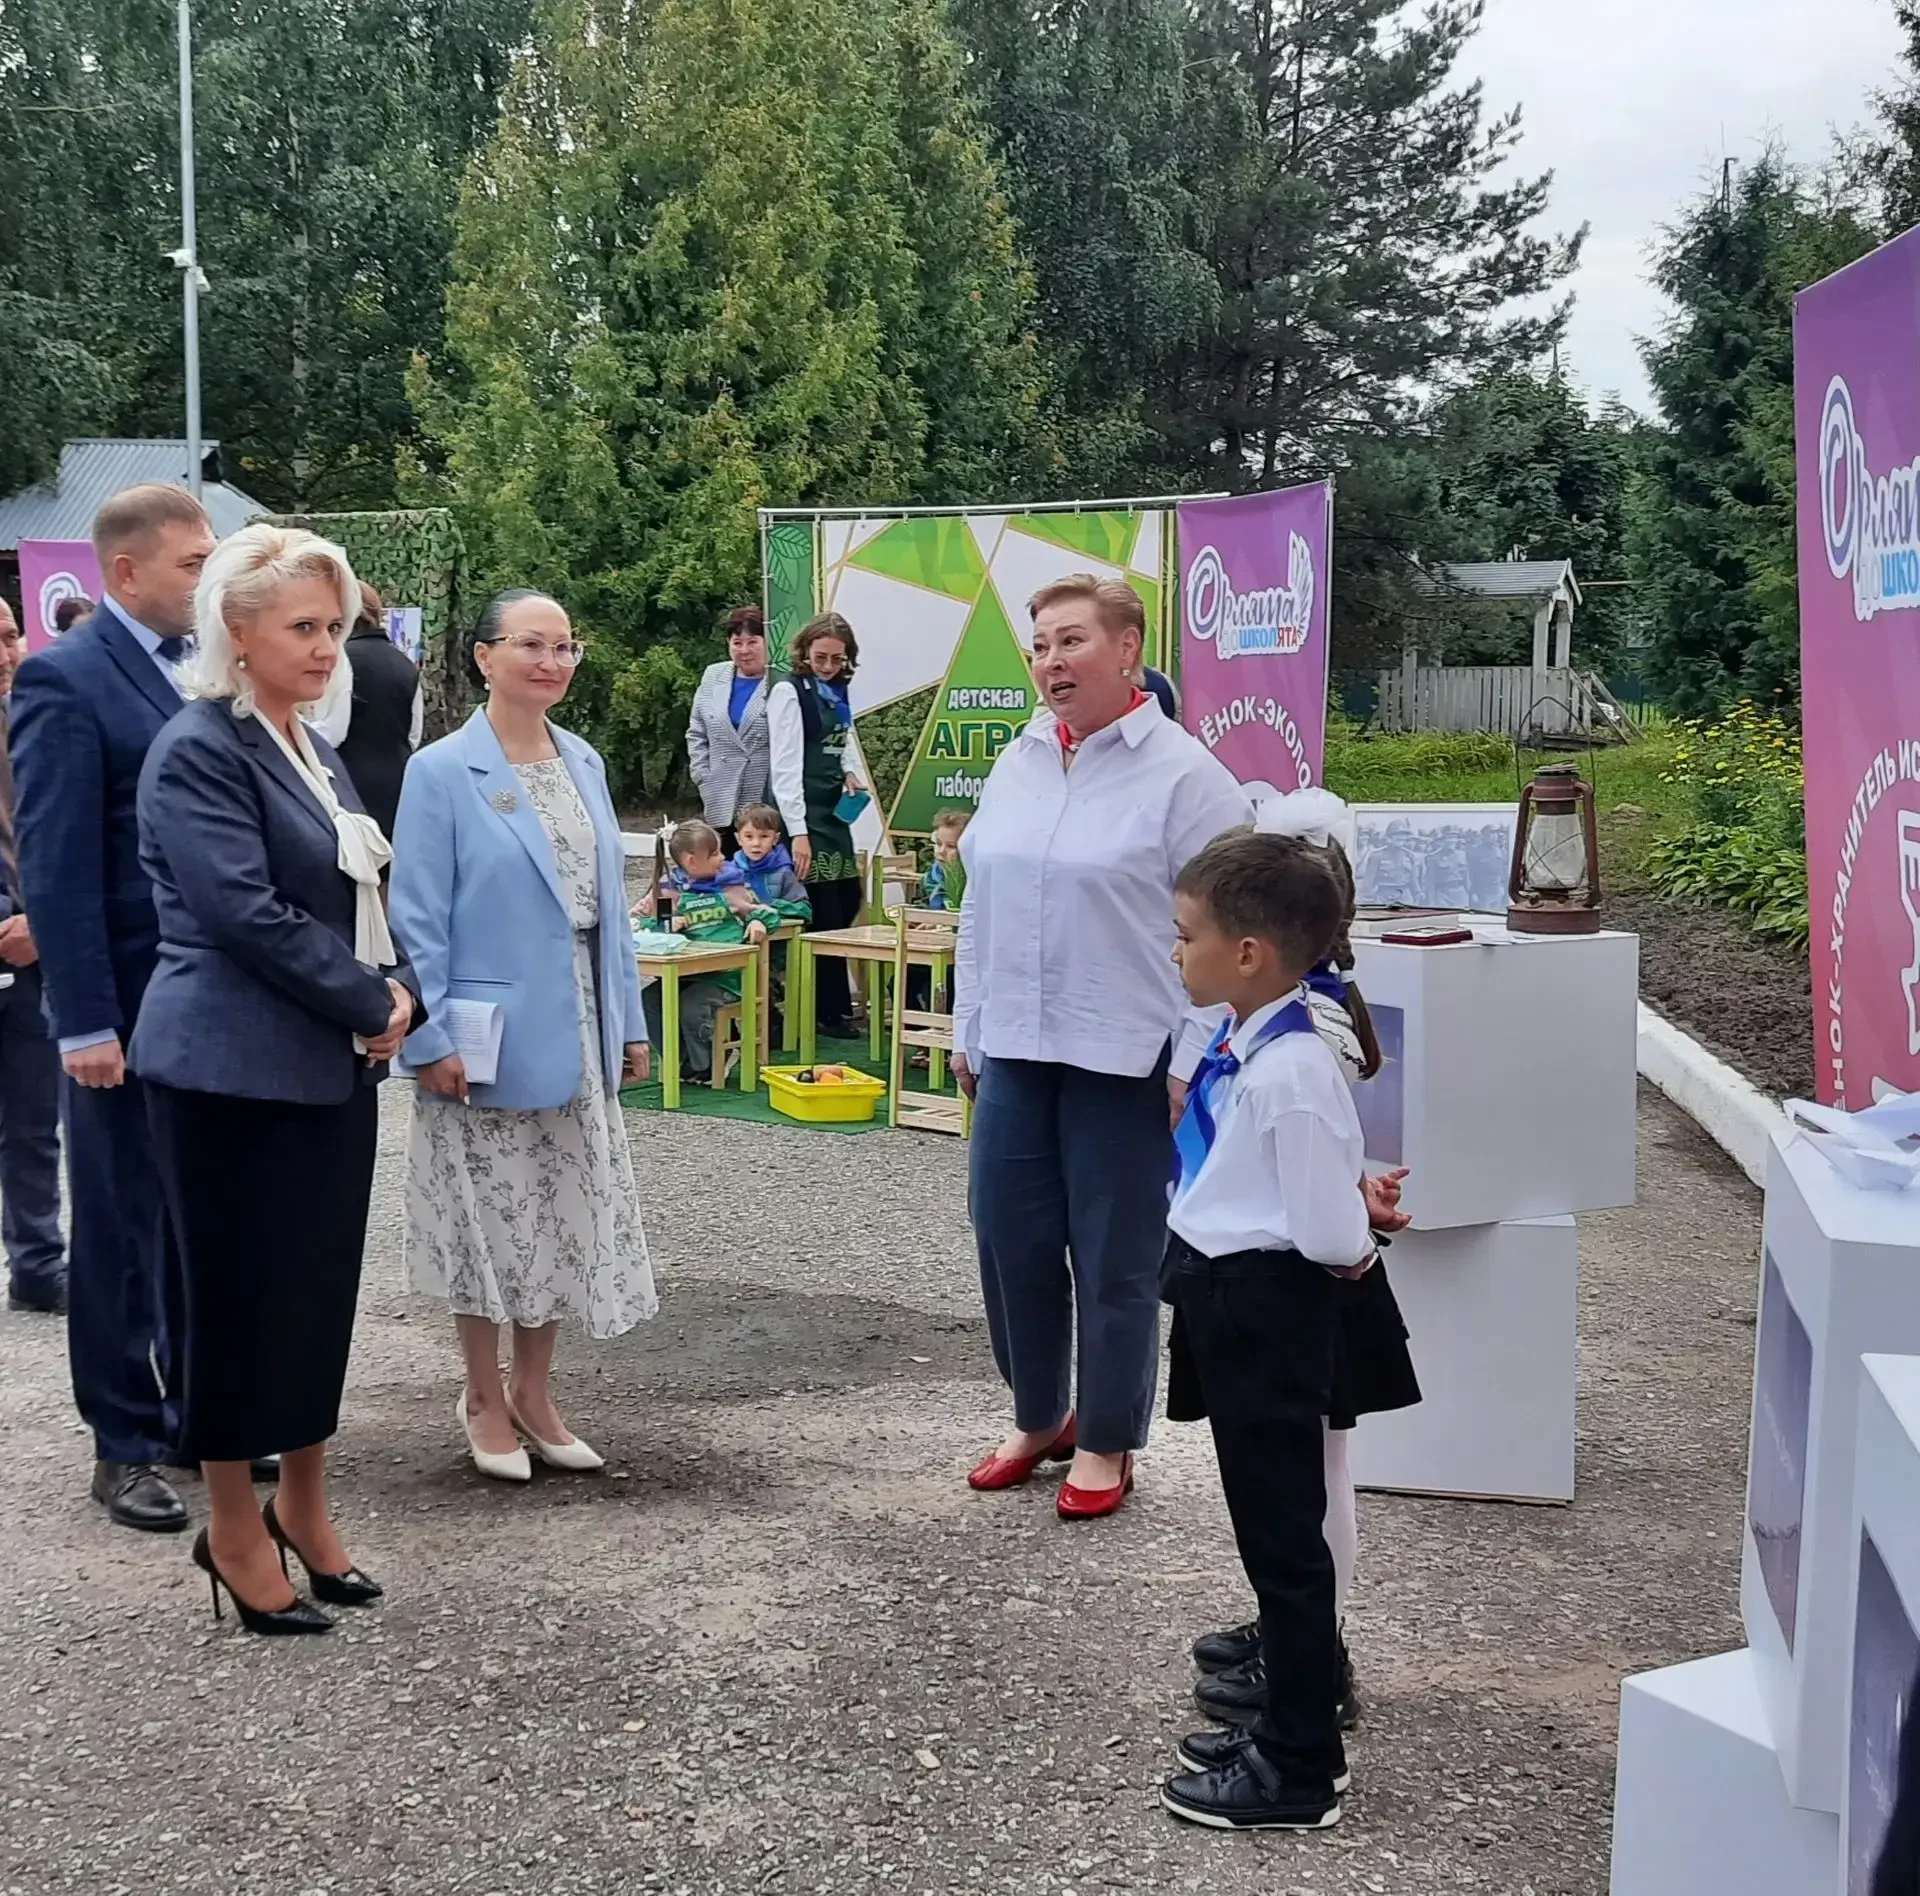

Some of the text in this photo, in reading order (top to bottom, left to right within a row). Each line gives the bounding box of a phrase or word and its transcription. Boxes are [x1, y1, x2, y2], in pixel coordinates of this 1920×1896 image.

[1191, 548, 1298, 643] Орлята
[1859, 550, 1920, 604] ДОШКО
[948, 688, 1025, 709] детская
[1199, 696, 1312, 789] ЁНОК-ЭКОЛО
[935, 769, 988, 806] лабор
